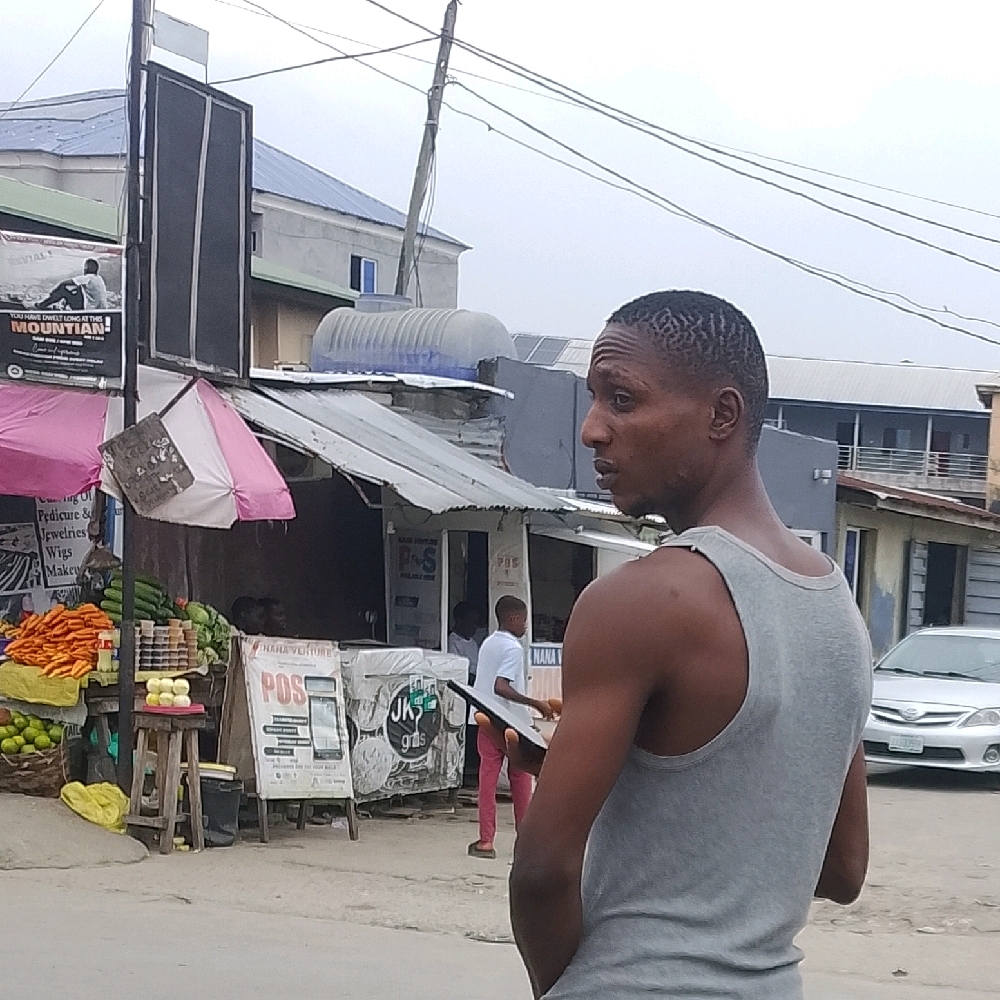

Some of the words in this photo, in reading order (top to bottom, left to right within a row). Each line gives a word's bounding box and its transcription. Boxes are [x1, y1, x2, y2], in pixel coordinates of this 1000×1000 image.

[10, 312, 24, 320] YOU
[42, 314, 63, 322] DWELT
[63, 315, 82, 323] LONG
[89, 315, 103, 323] THIS
[38, 508, 80, 525] Pedicure
[82, 507, 92, 520] &
[41, 526, 87, 542] Jewelries
[45, 545, 73, 562] Wigs
[261, 671, 308, 706] POS
